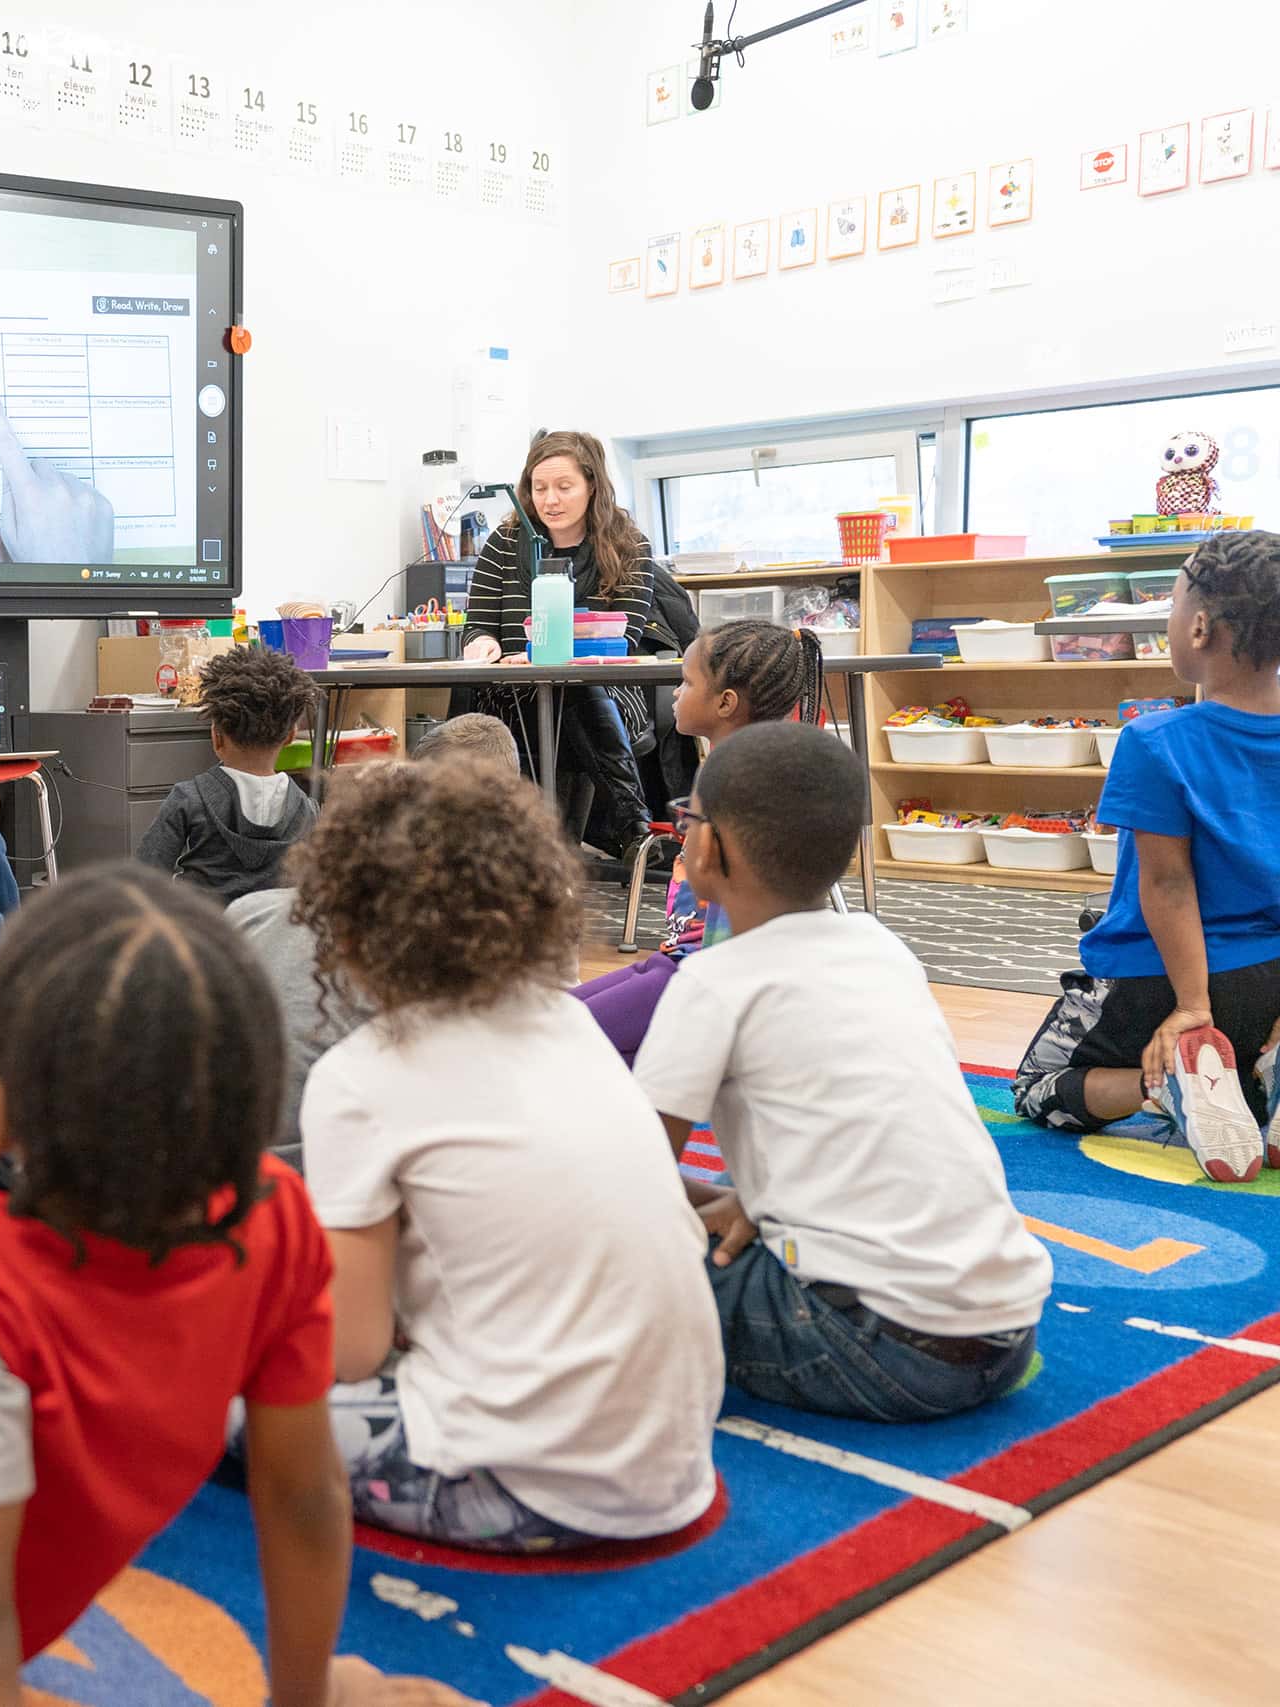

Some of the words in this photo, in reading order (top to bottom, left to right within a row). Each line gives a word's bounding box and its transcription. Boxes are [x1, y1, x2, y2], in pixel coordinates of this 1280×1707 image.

[2, 31, 29, 58] 10
[7, 66, 24, 80] ten
[128, 61, 153, 89] 12
[63, 77, 97, 95] eleven
[188, 73, 211, 99] 13
[124, 88, 158, 108] twelve
[243, 87, 266, 112] 14
[297, 101, 318, 126] 15
[348, 111, 369, 136] 16
[397, 122, 417, 144] 17
[444, 131, 464, 154] 18
[489, 142, 508, 164] 19
[531, 151, 551, 173] 20
[111, 300, 134, 312] Read,
[135, 300, 162, 312] Write,
[163, 301, 184, 312] Draw
